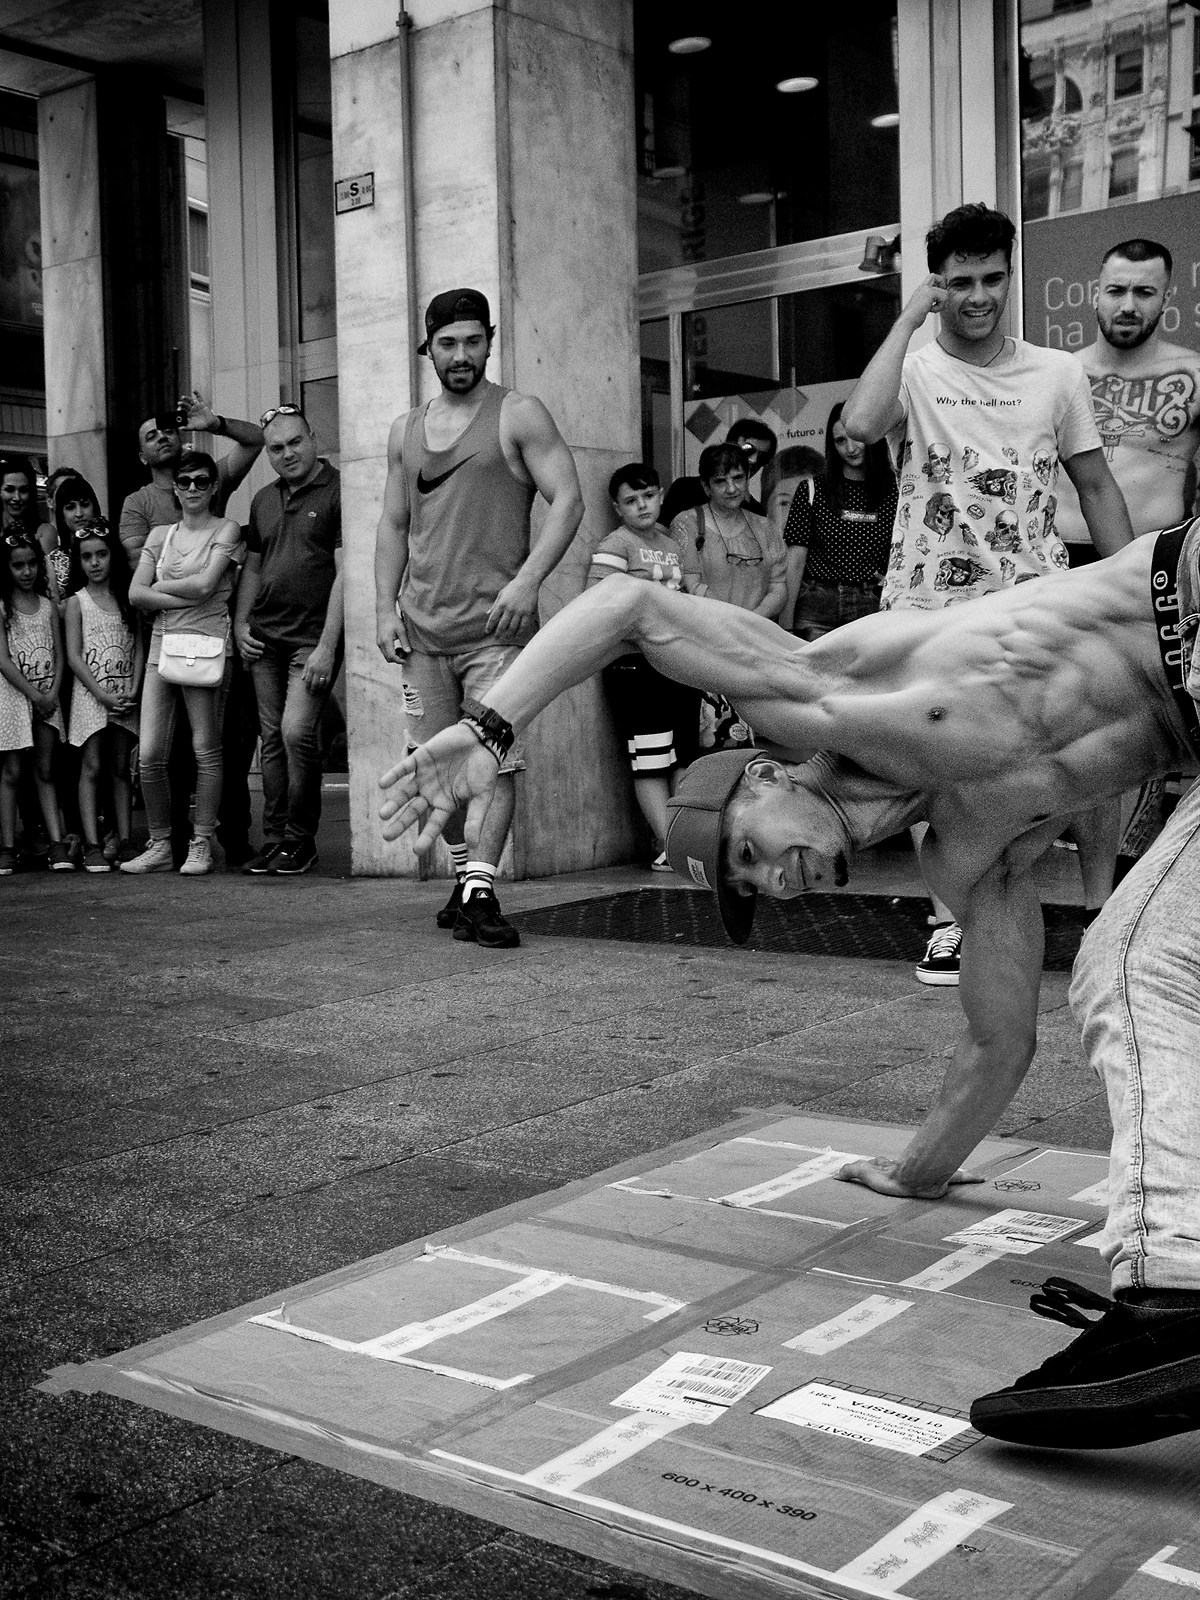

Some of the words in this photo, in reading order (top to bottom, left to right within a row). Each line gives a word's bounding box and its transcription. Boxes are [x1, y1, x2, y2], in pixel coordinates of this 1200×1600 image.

[350, 182, 359, 196] S
[1046, 315, 1084, 349] ha
[936, 396, 958, 407] Why
[961, 397, 977, 406] the
[980, 398, 997, 407] hell
[999, 398, 1022, 406] not?
[786, 428, 816, 438] futuro
[661, 1472, 700, 1487] 600
[700, 1484, 716, 1492] x
[718, 1488, 757, 1503] 400
[757, 1499, 774, 1508] x
[776, 1505, 817, 1521] 390
